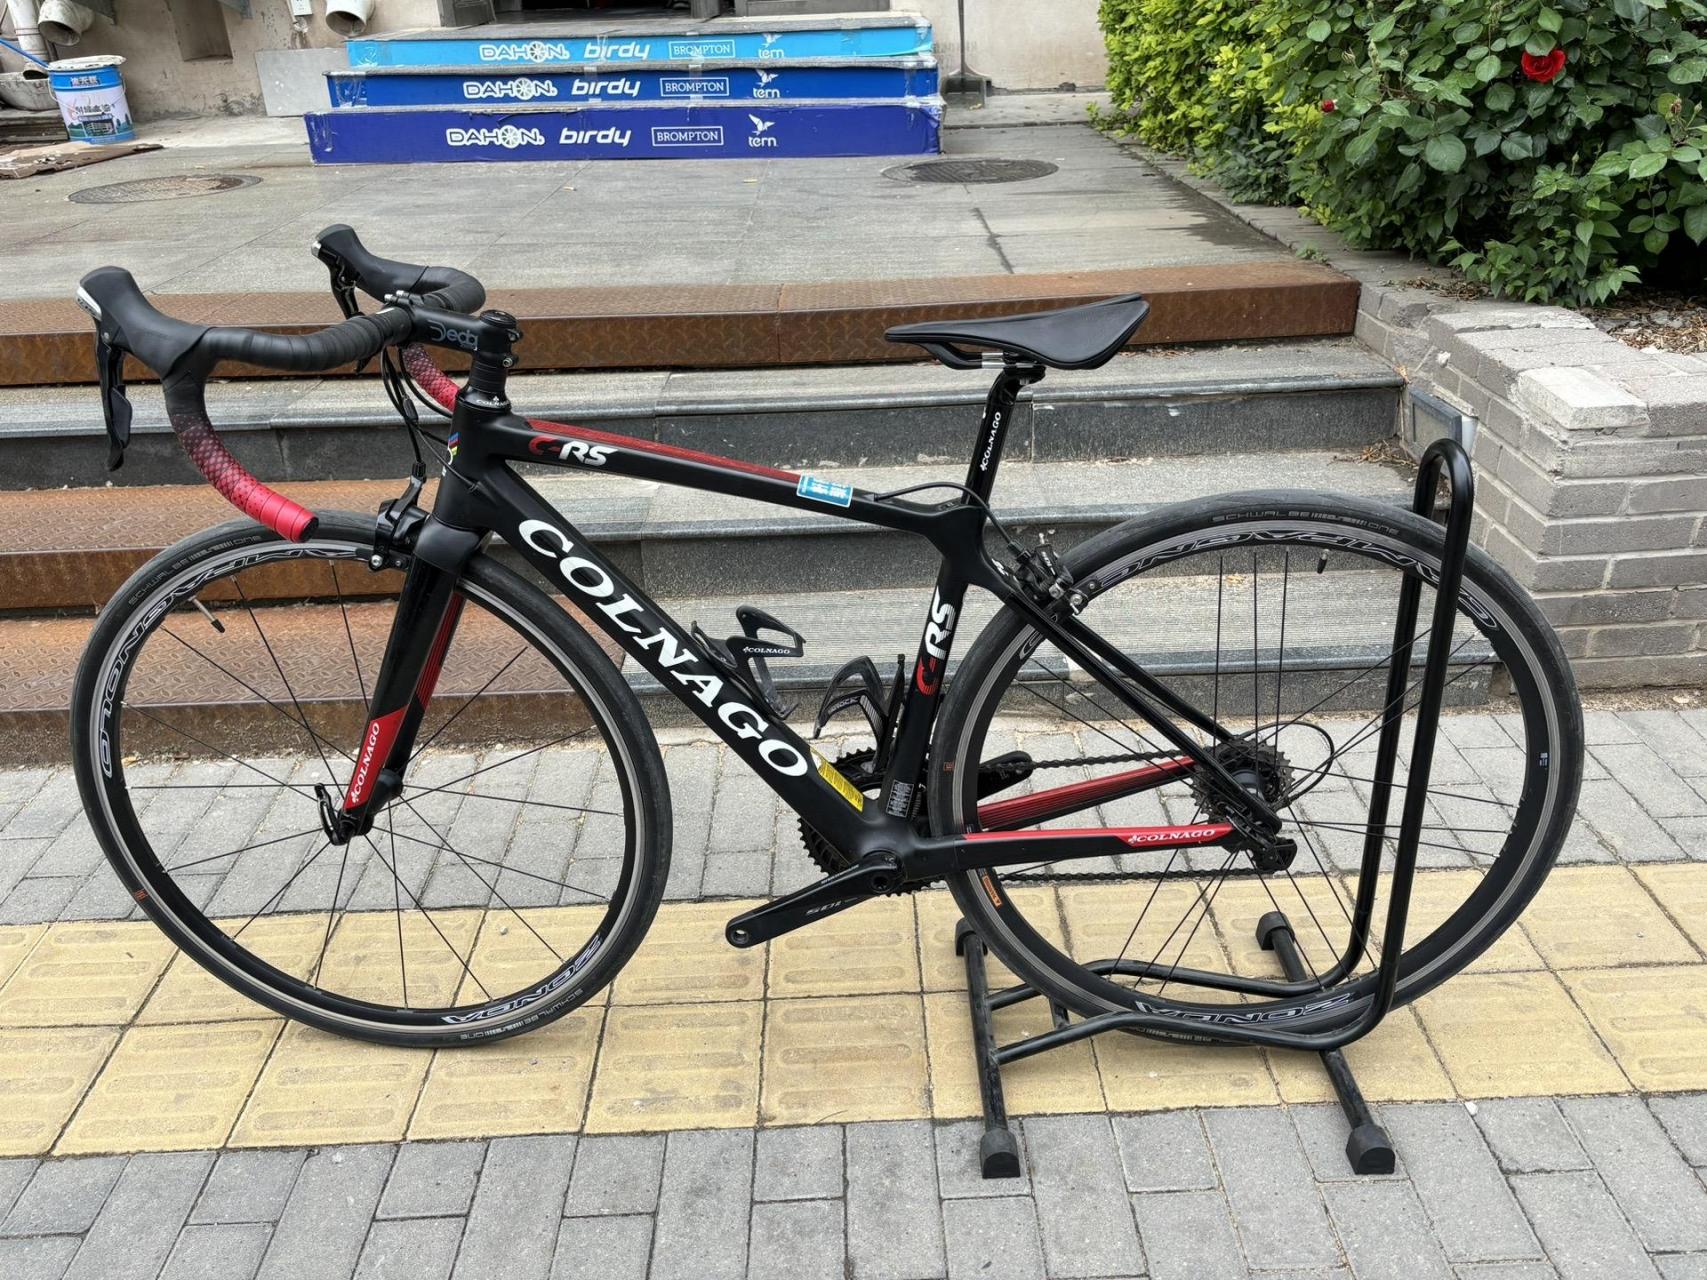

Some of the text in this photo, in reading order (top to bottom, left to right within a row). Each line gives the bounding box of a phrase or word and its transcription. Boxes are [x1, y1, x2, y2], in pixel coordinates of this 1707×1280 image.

[584, 41, 651, 60] birdy
[673, 44, 731, 56] BROMPTON
[758, 48, 785, 59] tern
[571, 77, 641, 97] birdy
[665, 81, 724, 92] BROMPTON
[753, 87, 780, 98] tern
[559, 126, 632, 147] birdy
[656, 130, 719, 142] BROMPTON
[748, 136, 777, 147] tern
[981, 411, 1001, 466] COLNAGO
[1212, 510, 1310, 522] SCHWALBE
[127, 555, 190, 606] SCHWALBE
[518, 519, 808, 777] COLNAGO
[748, 647, 791, 655] COLNAGO
[354, 722, 380, 796] COLNAGO
[1136, 829, 1216, 842] COLNAGO
[441, 934, 602, 1024] ZONDA
[524, 988, 583, 1025] SCHWALBE
